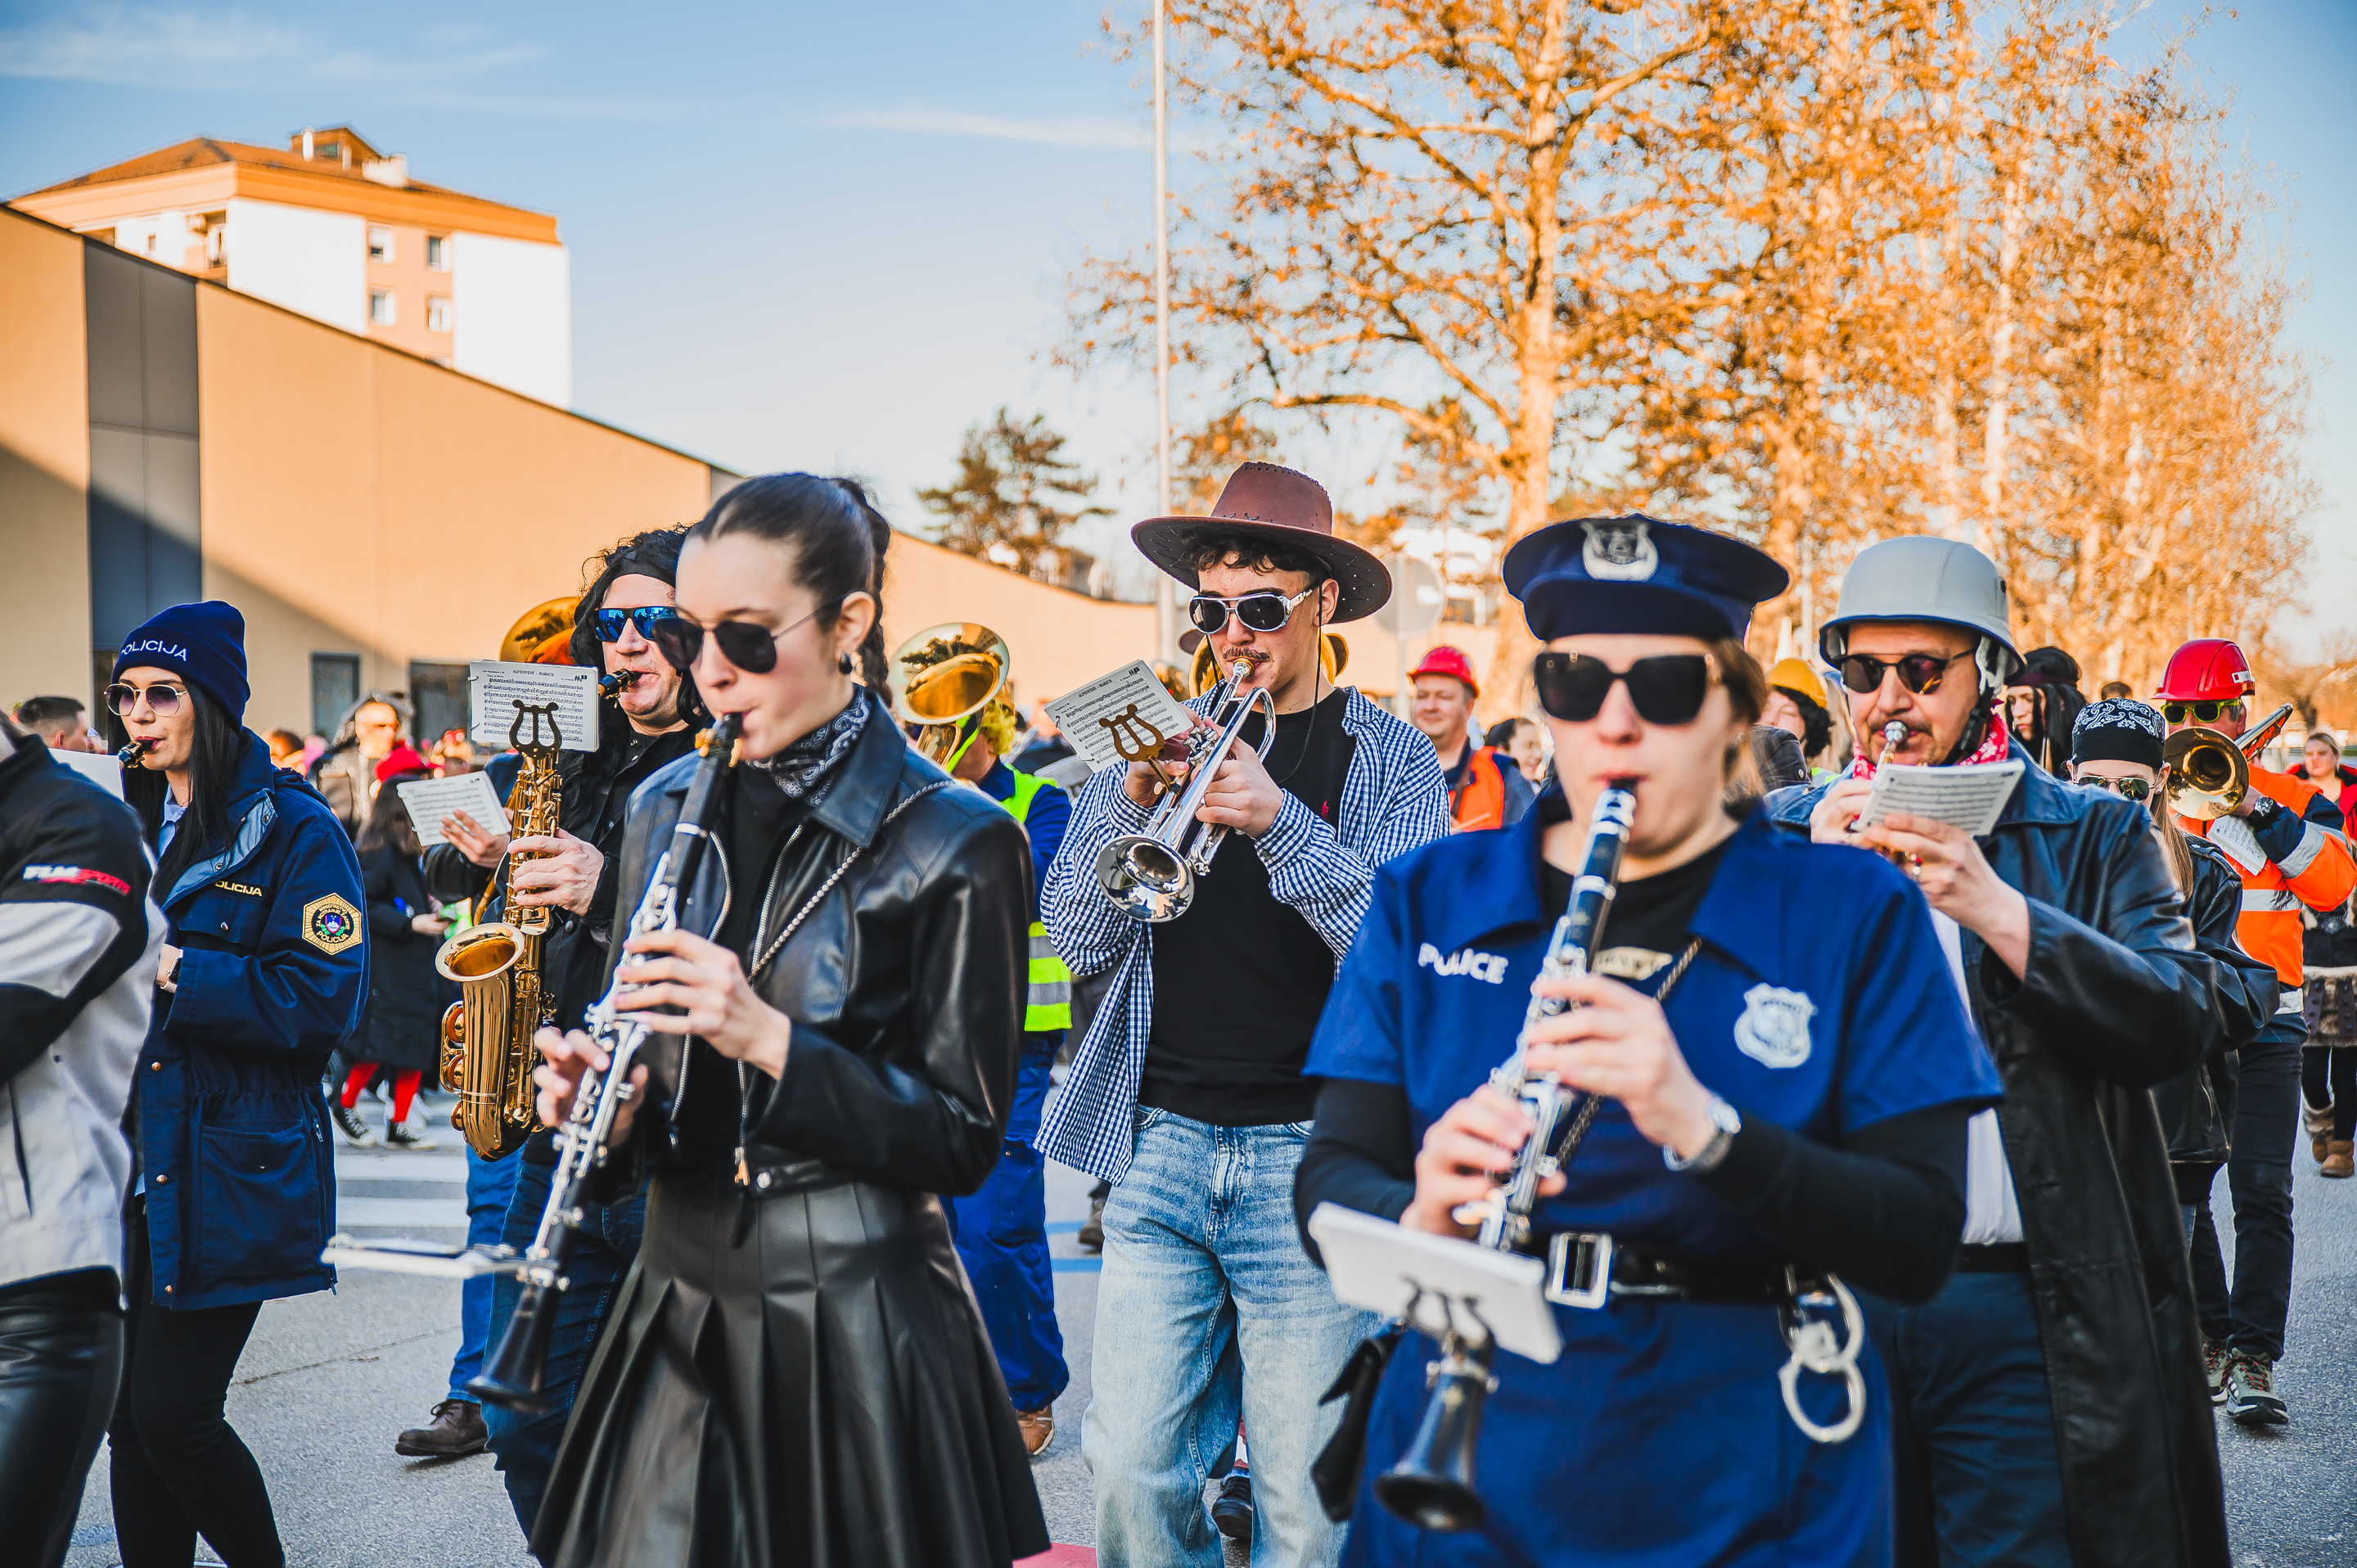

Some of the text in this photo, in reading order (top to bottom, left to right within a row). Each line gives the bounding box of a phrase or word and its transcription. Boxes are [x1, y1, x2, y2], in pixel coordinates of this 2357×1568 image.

[214, 881, 263, 897] OLICIJA
[316, 930, 349, 943] POLICIJA
[1418, 942, 1508, 985] POLICE
